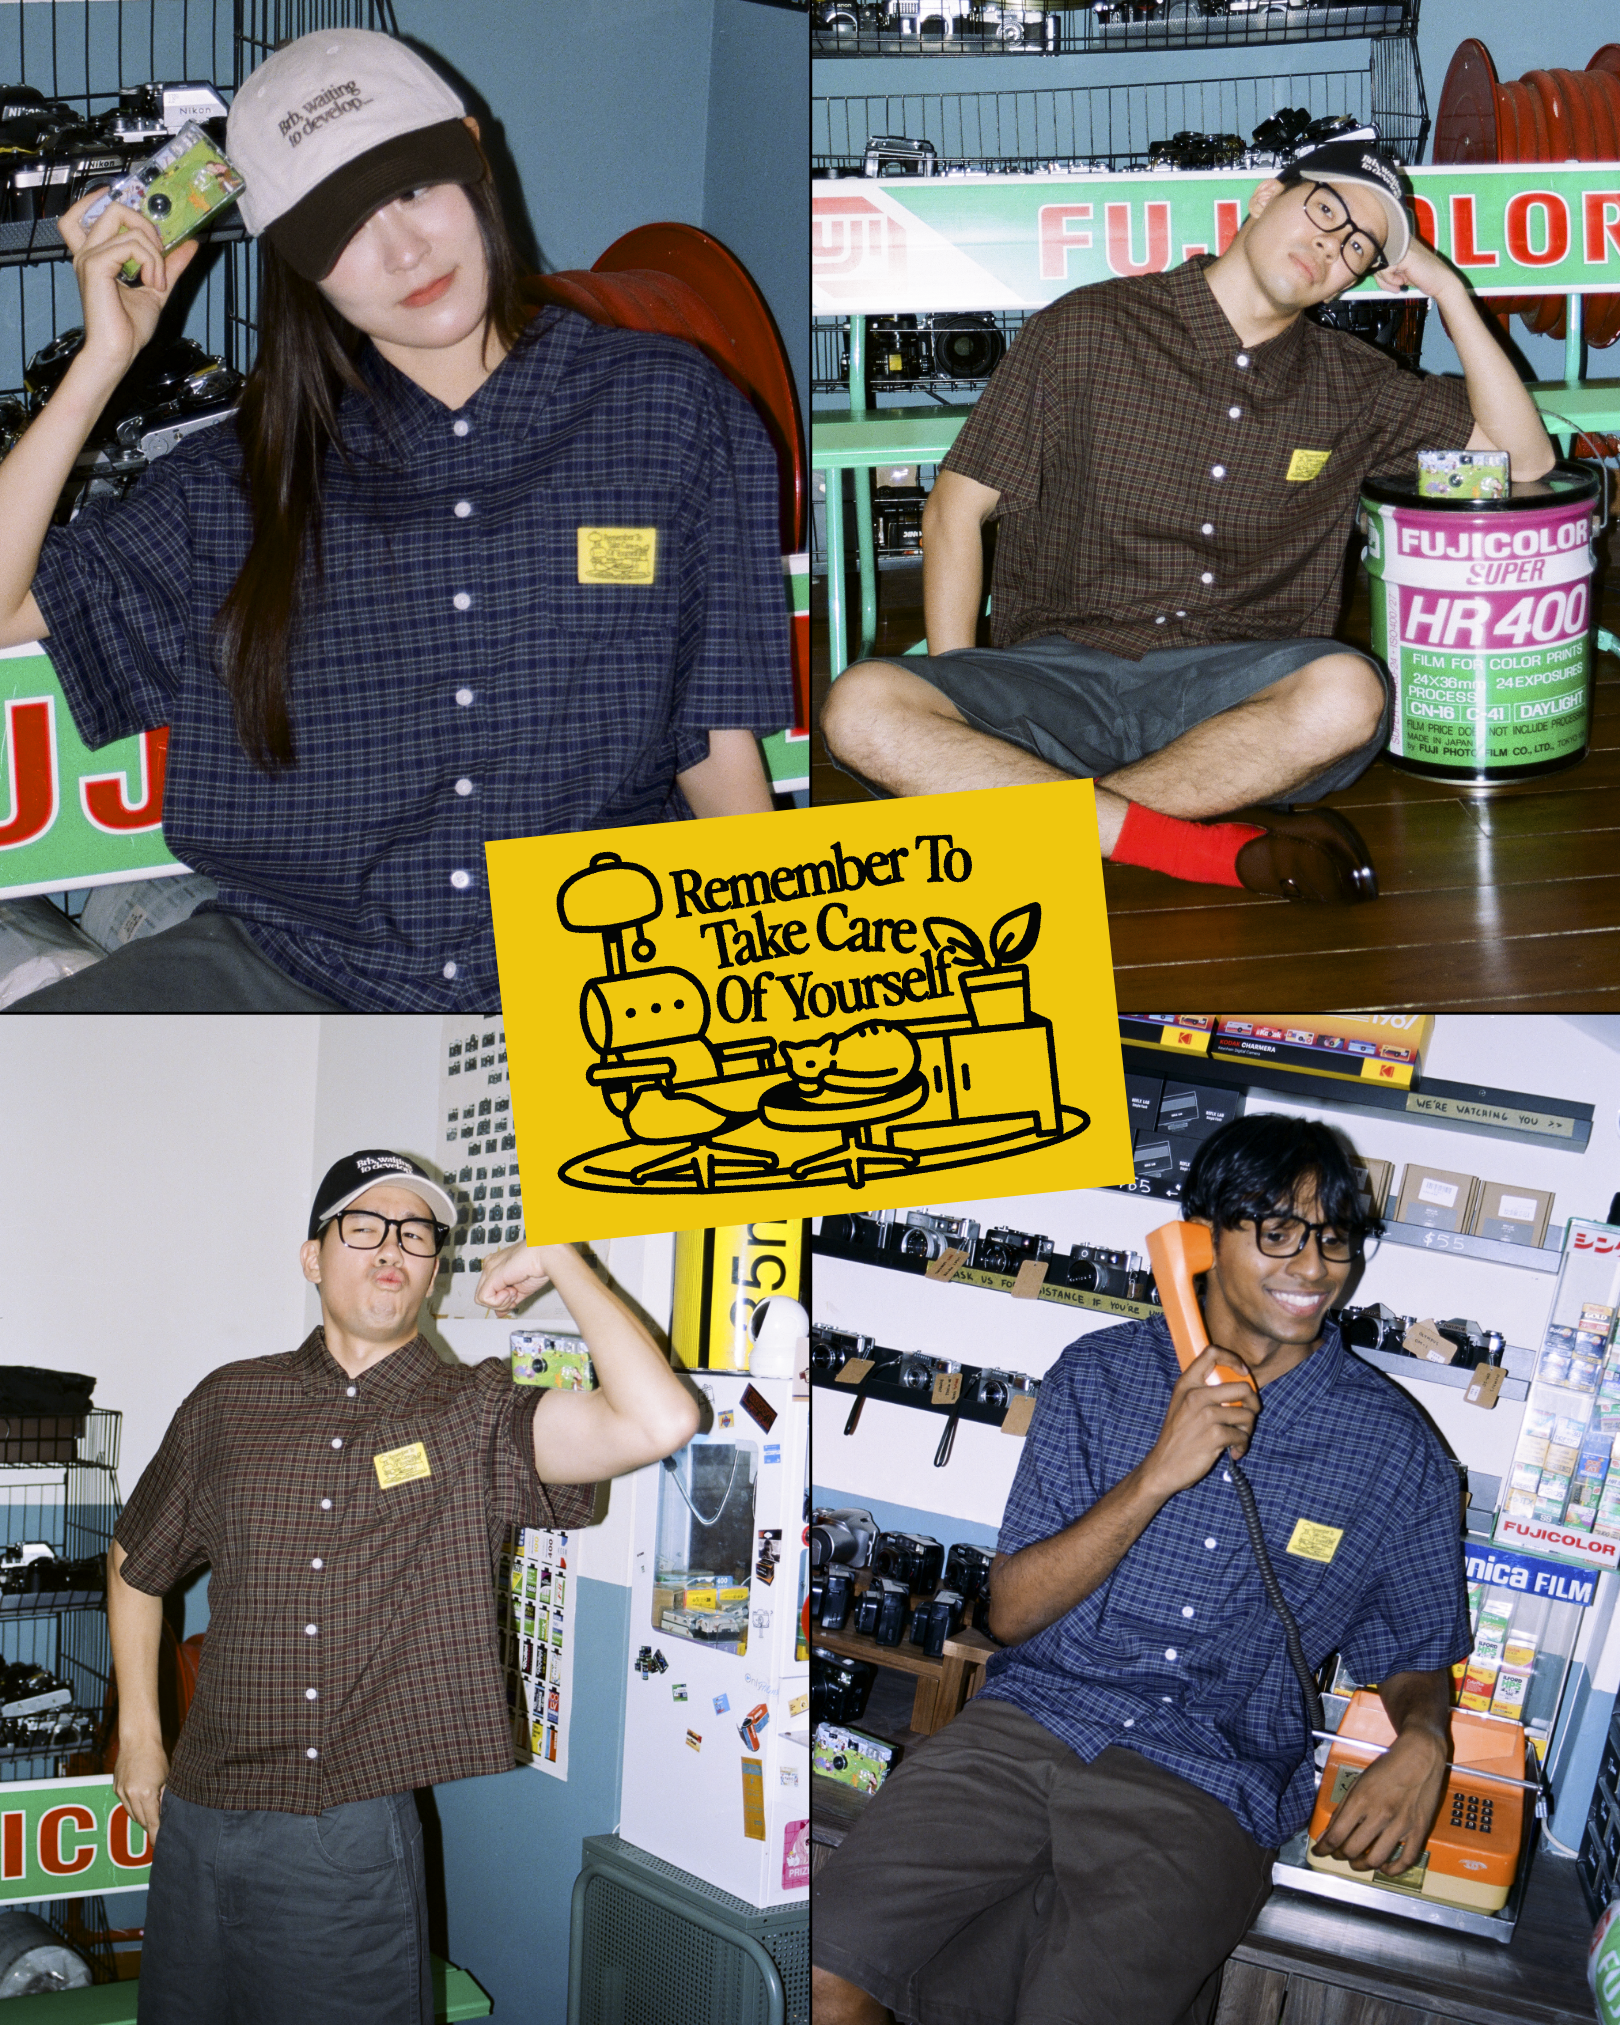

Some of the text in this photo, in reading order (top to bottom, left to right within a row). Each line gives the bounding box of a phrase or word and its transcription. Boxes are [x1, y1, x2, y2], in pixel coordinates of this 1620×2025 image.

[302, 80, 361, 114] waiting
[179, 106, 212, 116] Nikon
[288, 131, 302, 148] to
[1401, 518, 1589, 559] FUJICOLOR
[1466, 558, 1546, 586] SUPER
[1405, 583, 1587, 647] HR 400
[1412, 643, 1583, 671] FILM FOR COLOR PRINTS
[1408, 685, 1478, 703] PROCESS
[1410, 689, 1584, 721] CN-16 C-41 DAYLIGHT
[1406, 719, 1425, 733] FILM
[1428, 722, 1454, 736] PRICE
[1458, 725, 1484, 737] DOE
[1489, 725, 1508, 737] NOT
[1512, 720, 1549, 736] INCLUDE
[1407, 731, 1474, 748] MADE IN JAPAN
[1419, 743, 1439, 755] FUJI
[1443, 747, 1477, 758] PHOTO
[1485, 746, 1508, 758] FILM
[1219, 1039, 1276, 1053] KODAK CHARMERA
[1416, 1098, 1448, 1113] WE'RE
[1456, 1104, 1509, 1122] WATCHING
[1518, 1115, 1539, 1126] YOU
[1423, 1231, 1465, 1250] $55
[953, 1270, 974, 1281] ASK
[981, 1276, 994, 1286] US
[1001, 1279, 1016, 1289] FO
[1093, 1299, 1101, 1308] IF
[1110, 1301, 1140, 1315] YOU'RE
[1584, 1312, 1608, 1321] GOLD
[1555, 1434, 1579, 1447] PRESTO
[1539, 1514, 1553, 1523] SS
[1503, 1520, 1616, 1557] FUJICOLOR
[1465, 1555, 1593, 1604] nica FILM
[1476, 1646, 1498, 1657] HP5
[1478, 1640, 1498, 1649] ILFORD
[1501, 1679, 1522, 1690] HP5
[1502, 1675, 1523, 1684] ILFORD
